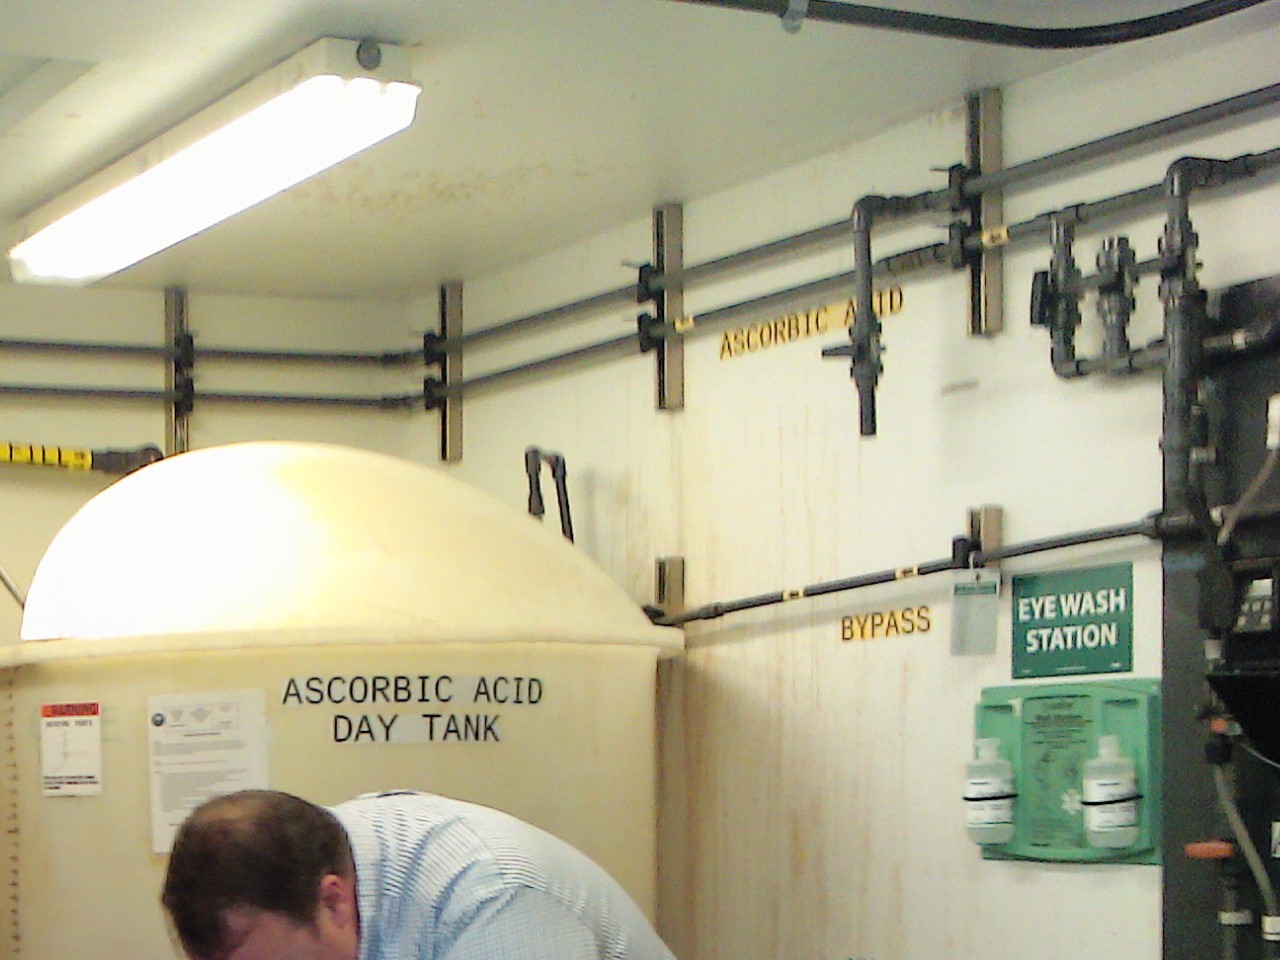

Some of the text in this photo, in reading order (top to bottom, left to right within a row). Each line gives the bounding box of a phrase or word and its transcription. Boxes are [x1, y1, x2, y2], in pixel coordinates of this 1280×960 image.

[719, 287, 904, 361] ASCORBIC AID
[1017, 587, 1126, 623] EYE WASH
[841, 605, 931, 641] BYPASS
[1025, 622, 1118, 654] STATION
[282, 675, 543, 705] ASCORBIC ACID
[333, 713, 500, 743] DAY TANK
